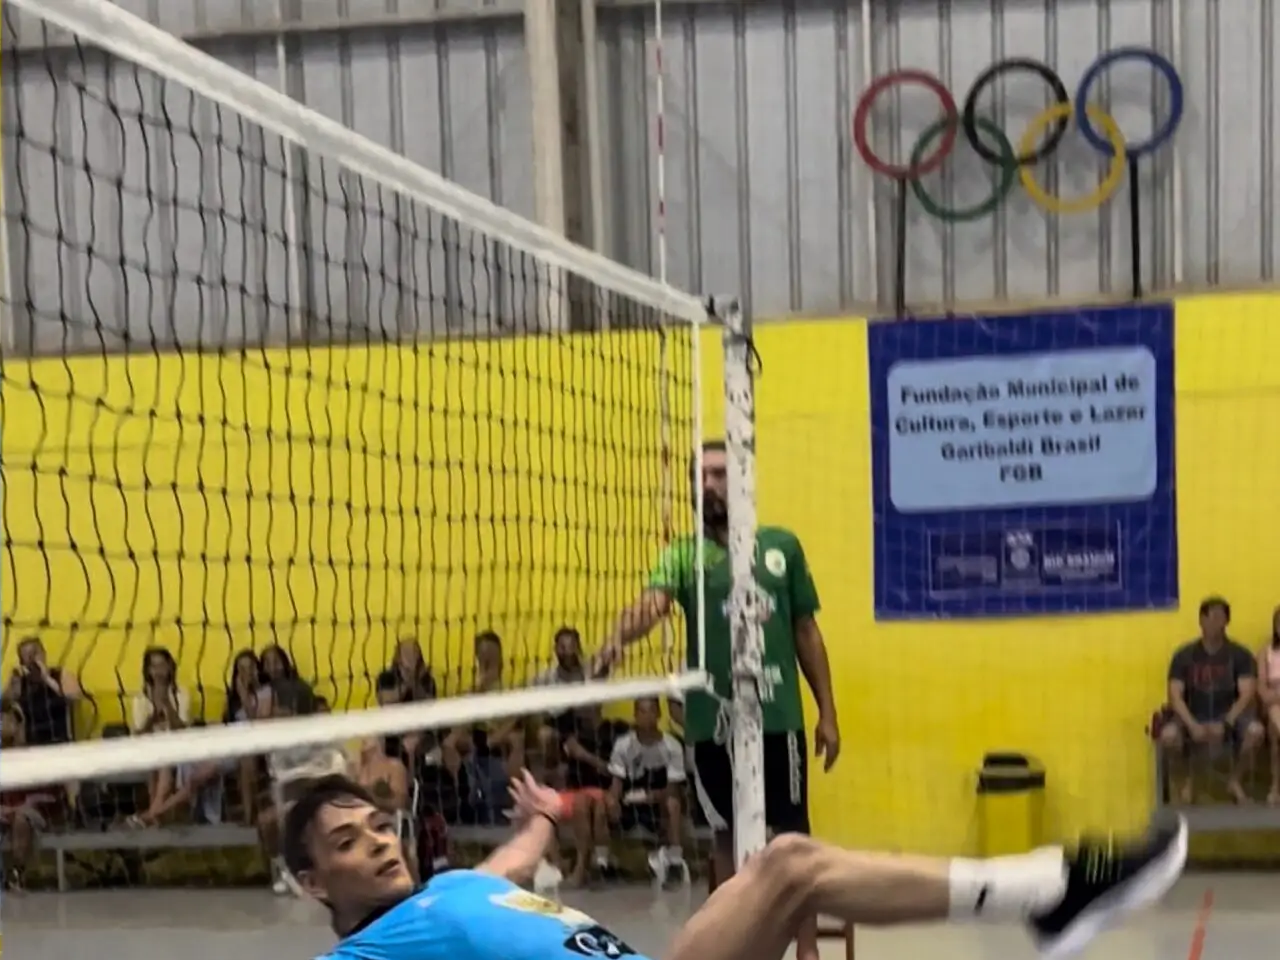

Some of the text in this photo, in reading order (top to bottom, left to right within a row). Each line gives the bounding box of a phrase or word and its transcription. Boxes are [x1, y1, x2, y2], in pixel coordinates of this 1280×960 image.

[900, 372, 1140, 406] Fundação Municipal de
[894, 404, 1146, 435] Cultura, Esporte e Lazer
[940, 434, 1101, 461] Garibaldi Brasil
